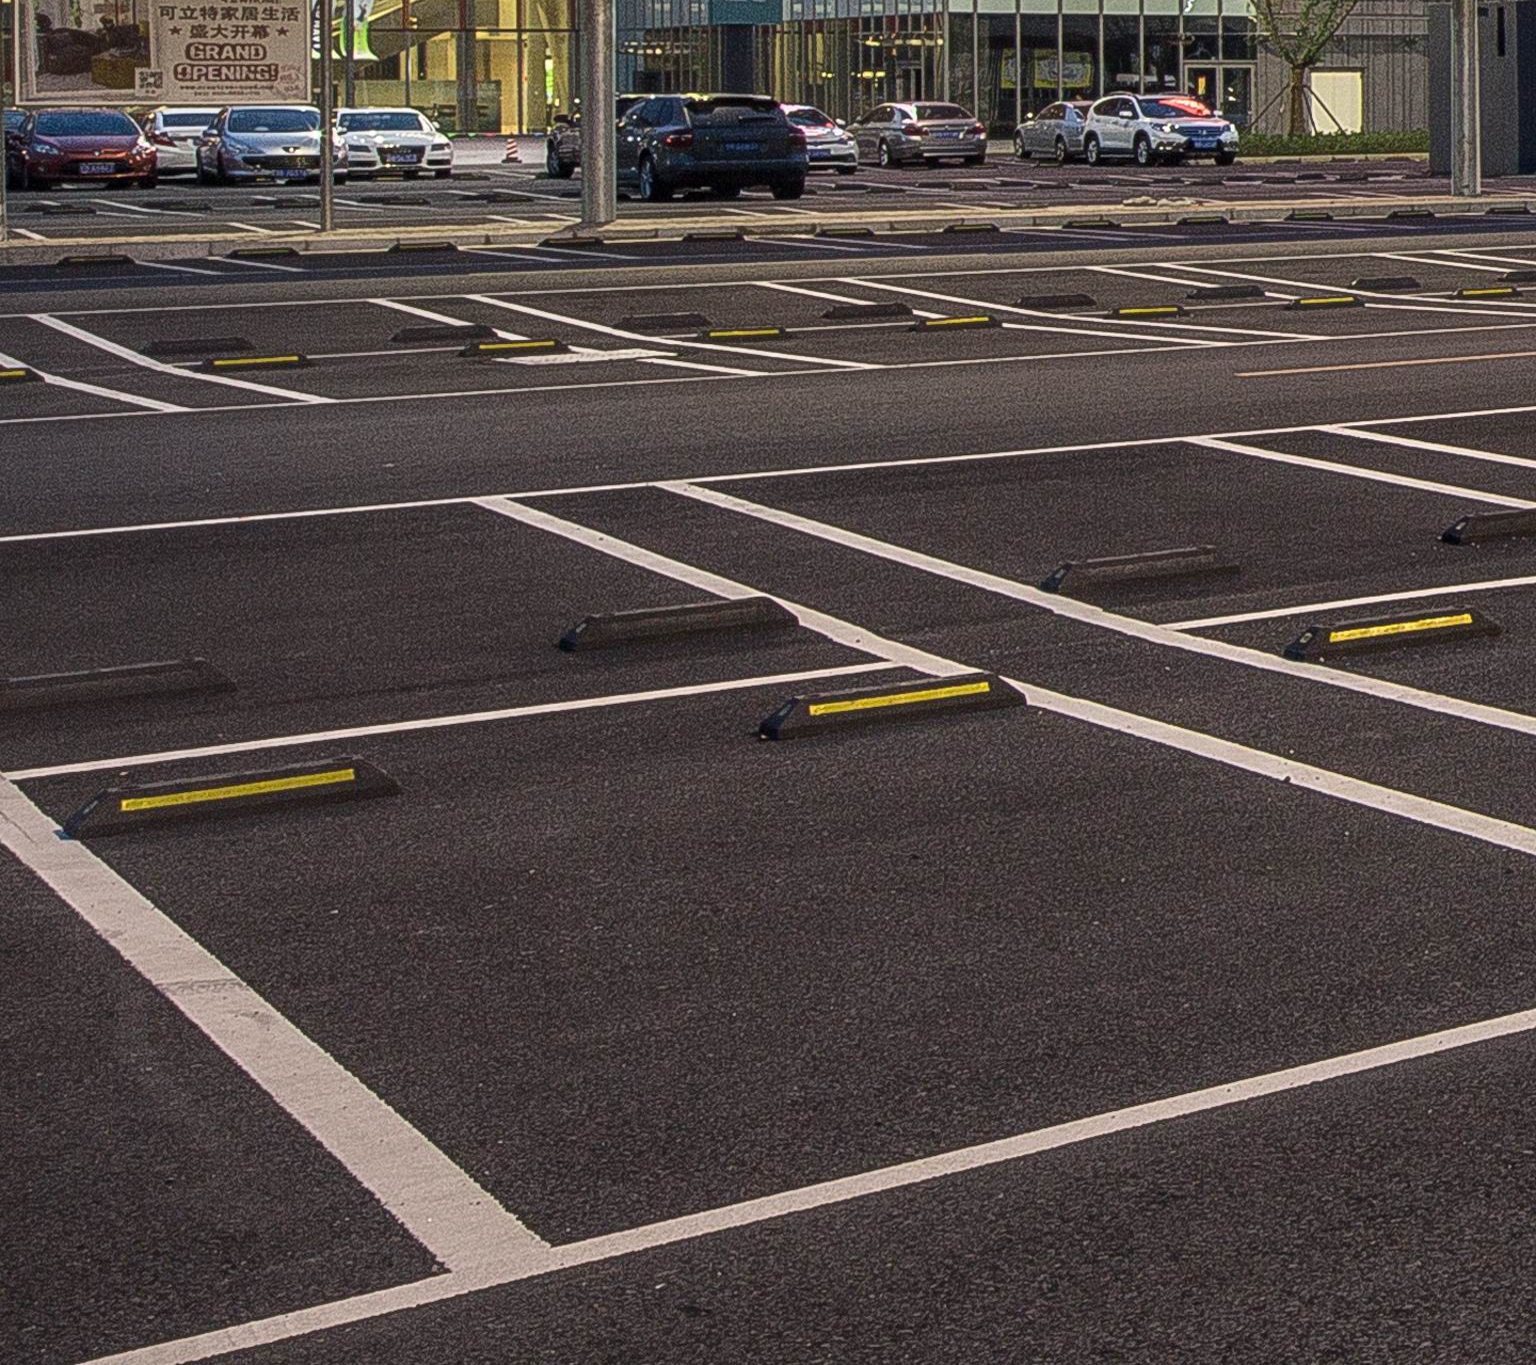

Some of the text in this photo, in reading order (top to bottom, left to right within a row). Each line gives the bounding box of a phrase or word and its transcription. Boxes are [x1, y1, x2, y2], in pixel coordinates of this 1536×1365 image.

[159, 5, 300, 22] 可立特家居生活
[189, 24, 270, 39] 盛大开幕
[189, 45, 265, 60] GRAND
